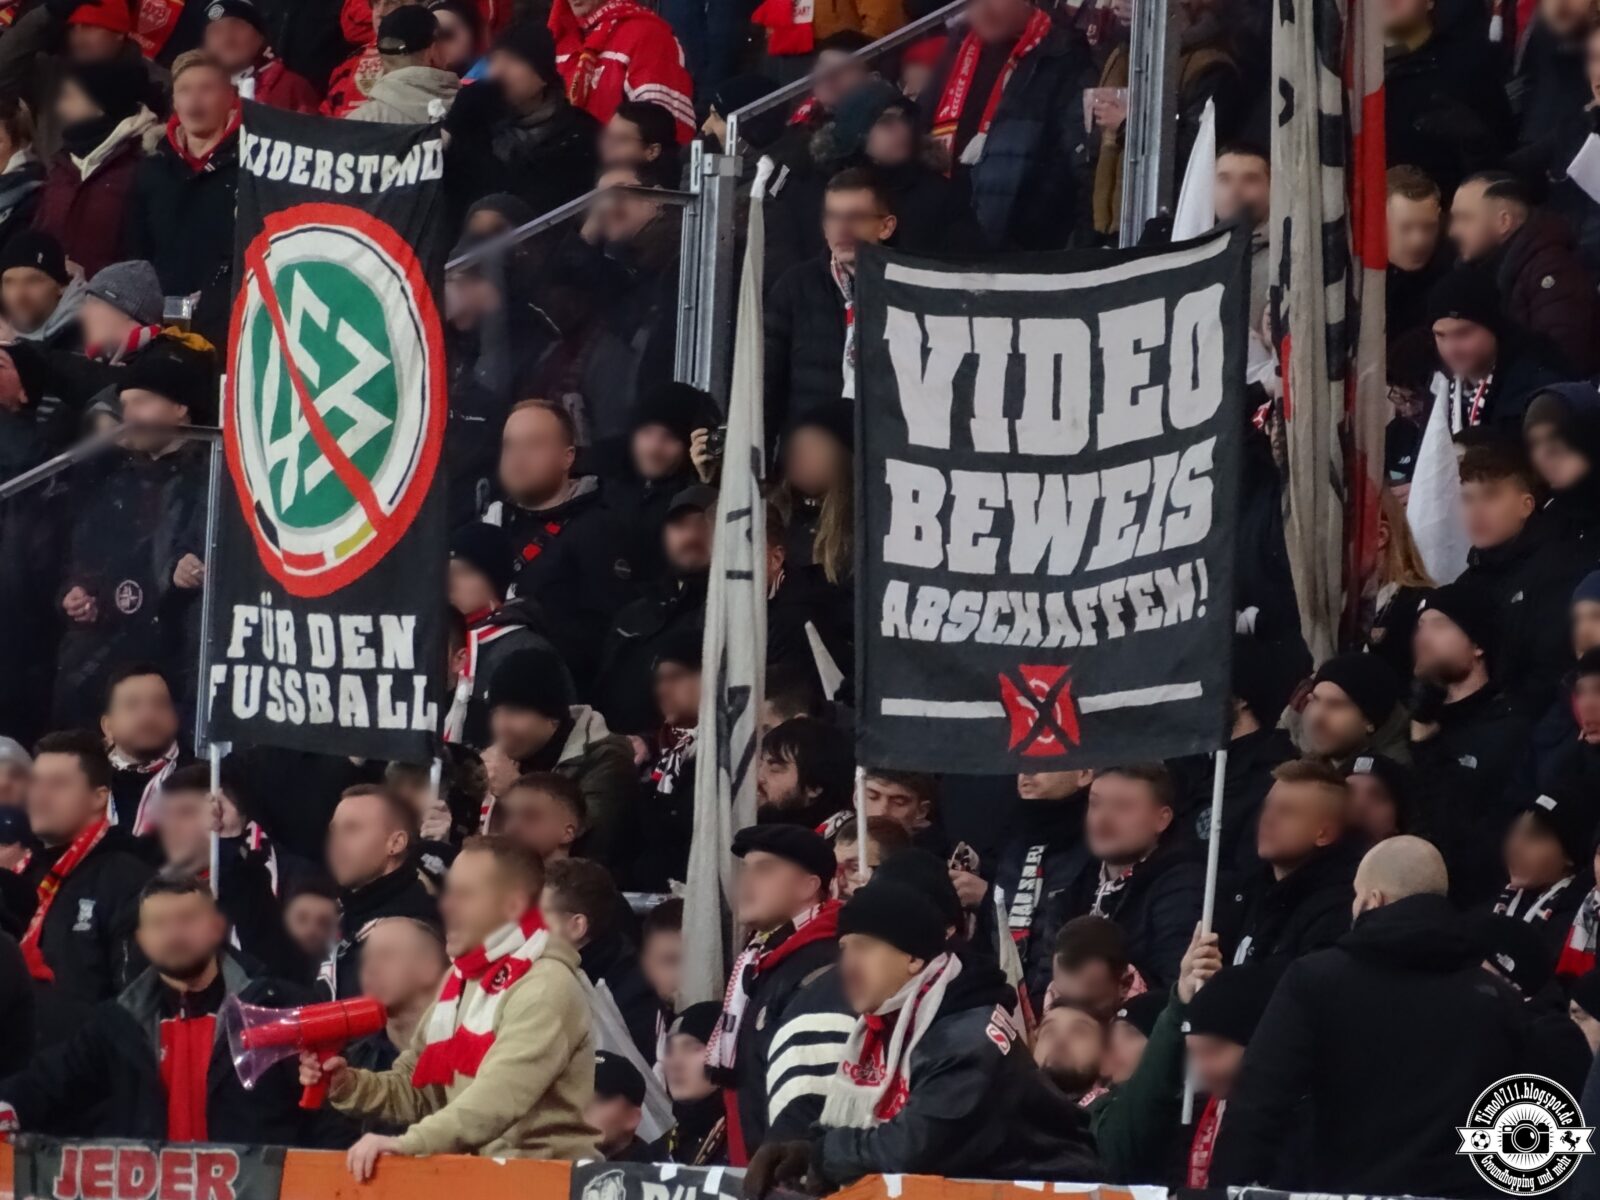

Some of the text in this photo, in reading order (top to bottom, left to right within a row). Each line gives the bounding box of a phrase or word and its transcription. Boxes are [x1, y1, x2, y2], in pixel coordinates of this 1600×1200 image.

[883, 282, 1225, 456] VIDEO
[883, 436, 1217, 576] BEWEIS
[227, 591, 416, 669] FÜR DEN
[881, 558, 1209, 648] ABSCHAFFEN!
[208, 664, 438, 732] FUSSBALL
[53, 1146, 240, 1200] JEDER
